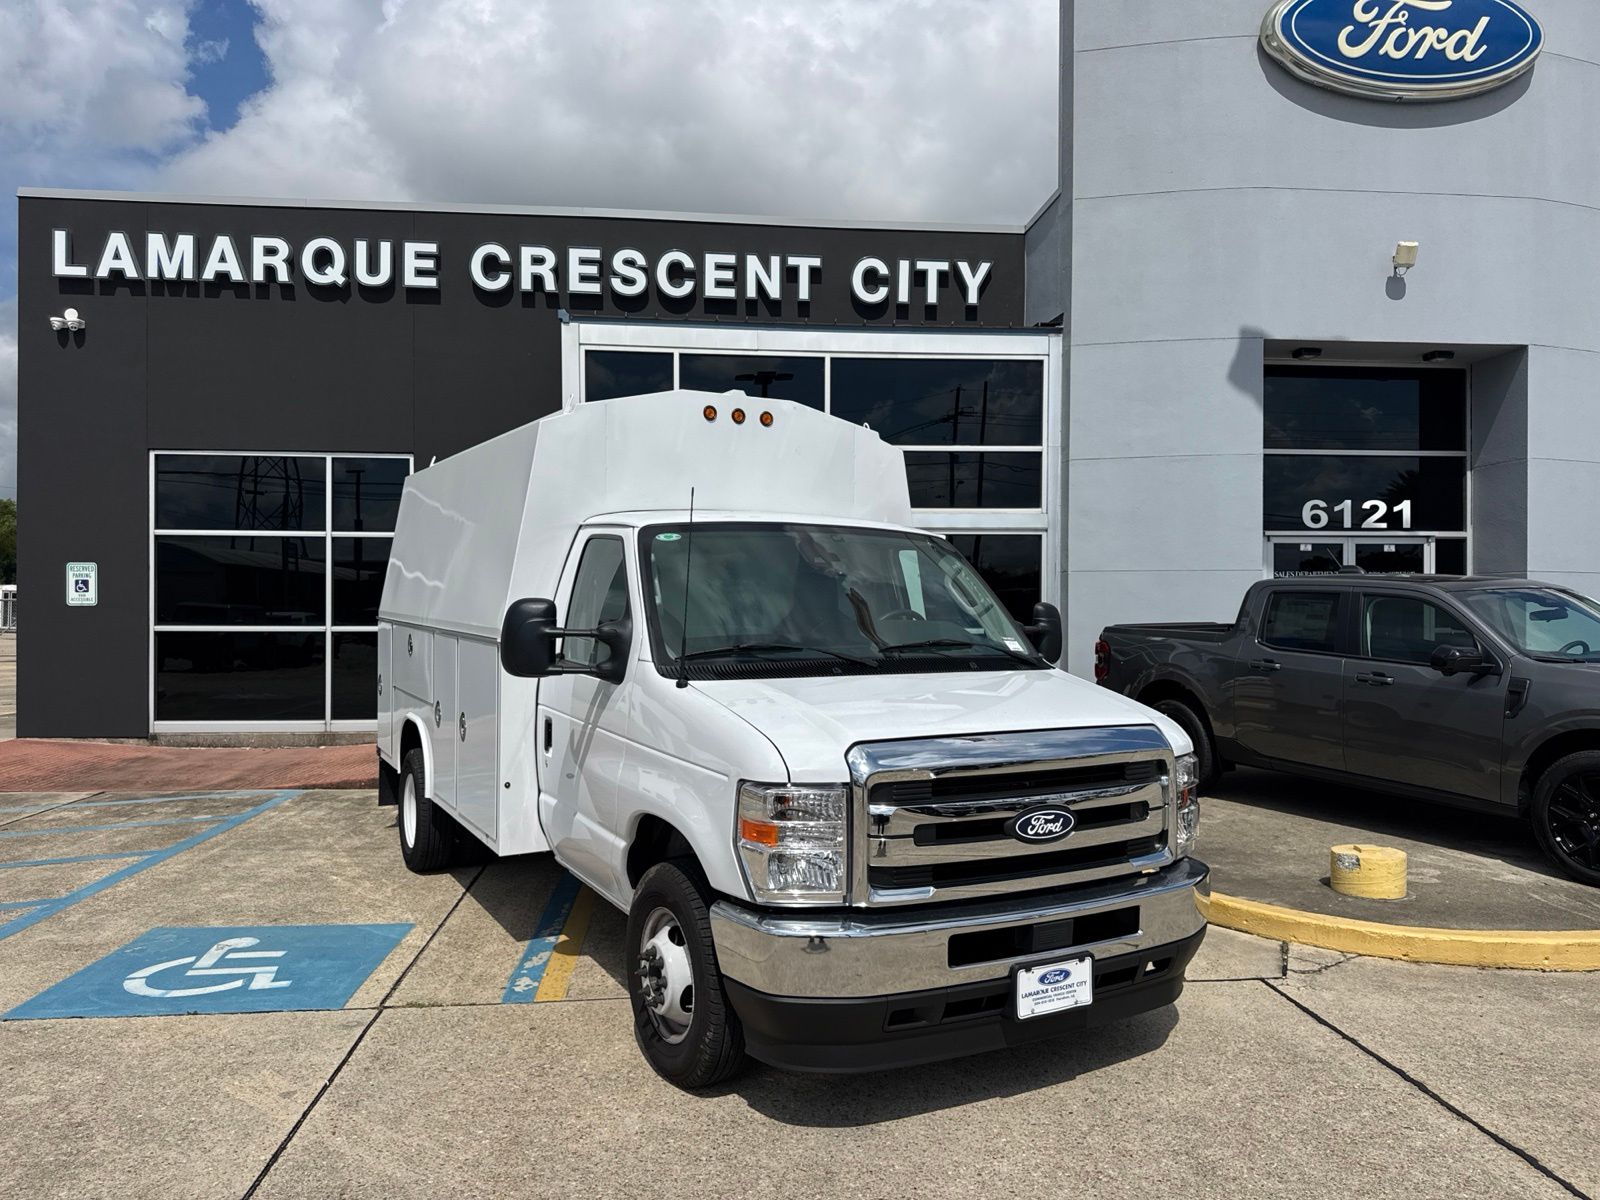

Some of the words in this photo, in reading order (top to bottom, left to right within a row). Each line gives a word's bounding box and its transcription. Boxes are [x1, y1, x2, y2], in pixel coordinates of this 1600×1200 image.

[1337, 0, 1491, 62] Ford
[52, 229, 440, 288] LAMARQUE
[470, 241, 822, 301] CRESCENT
[850, 256, 994, 305] CITY
[1302, 500, 1411, 528] 6121
[1027, 814, 1064, 834] Ford
[1044, 970, 1065, 983] Ford
[1050, 982, 1074, 992] CRESCENT
